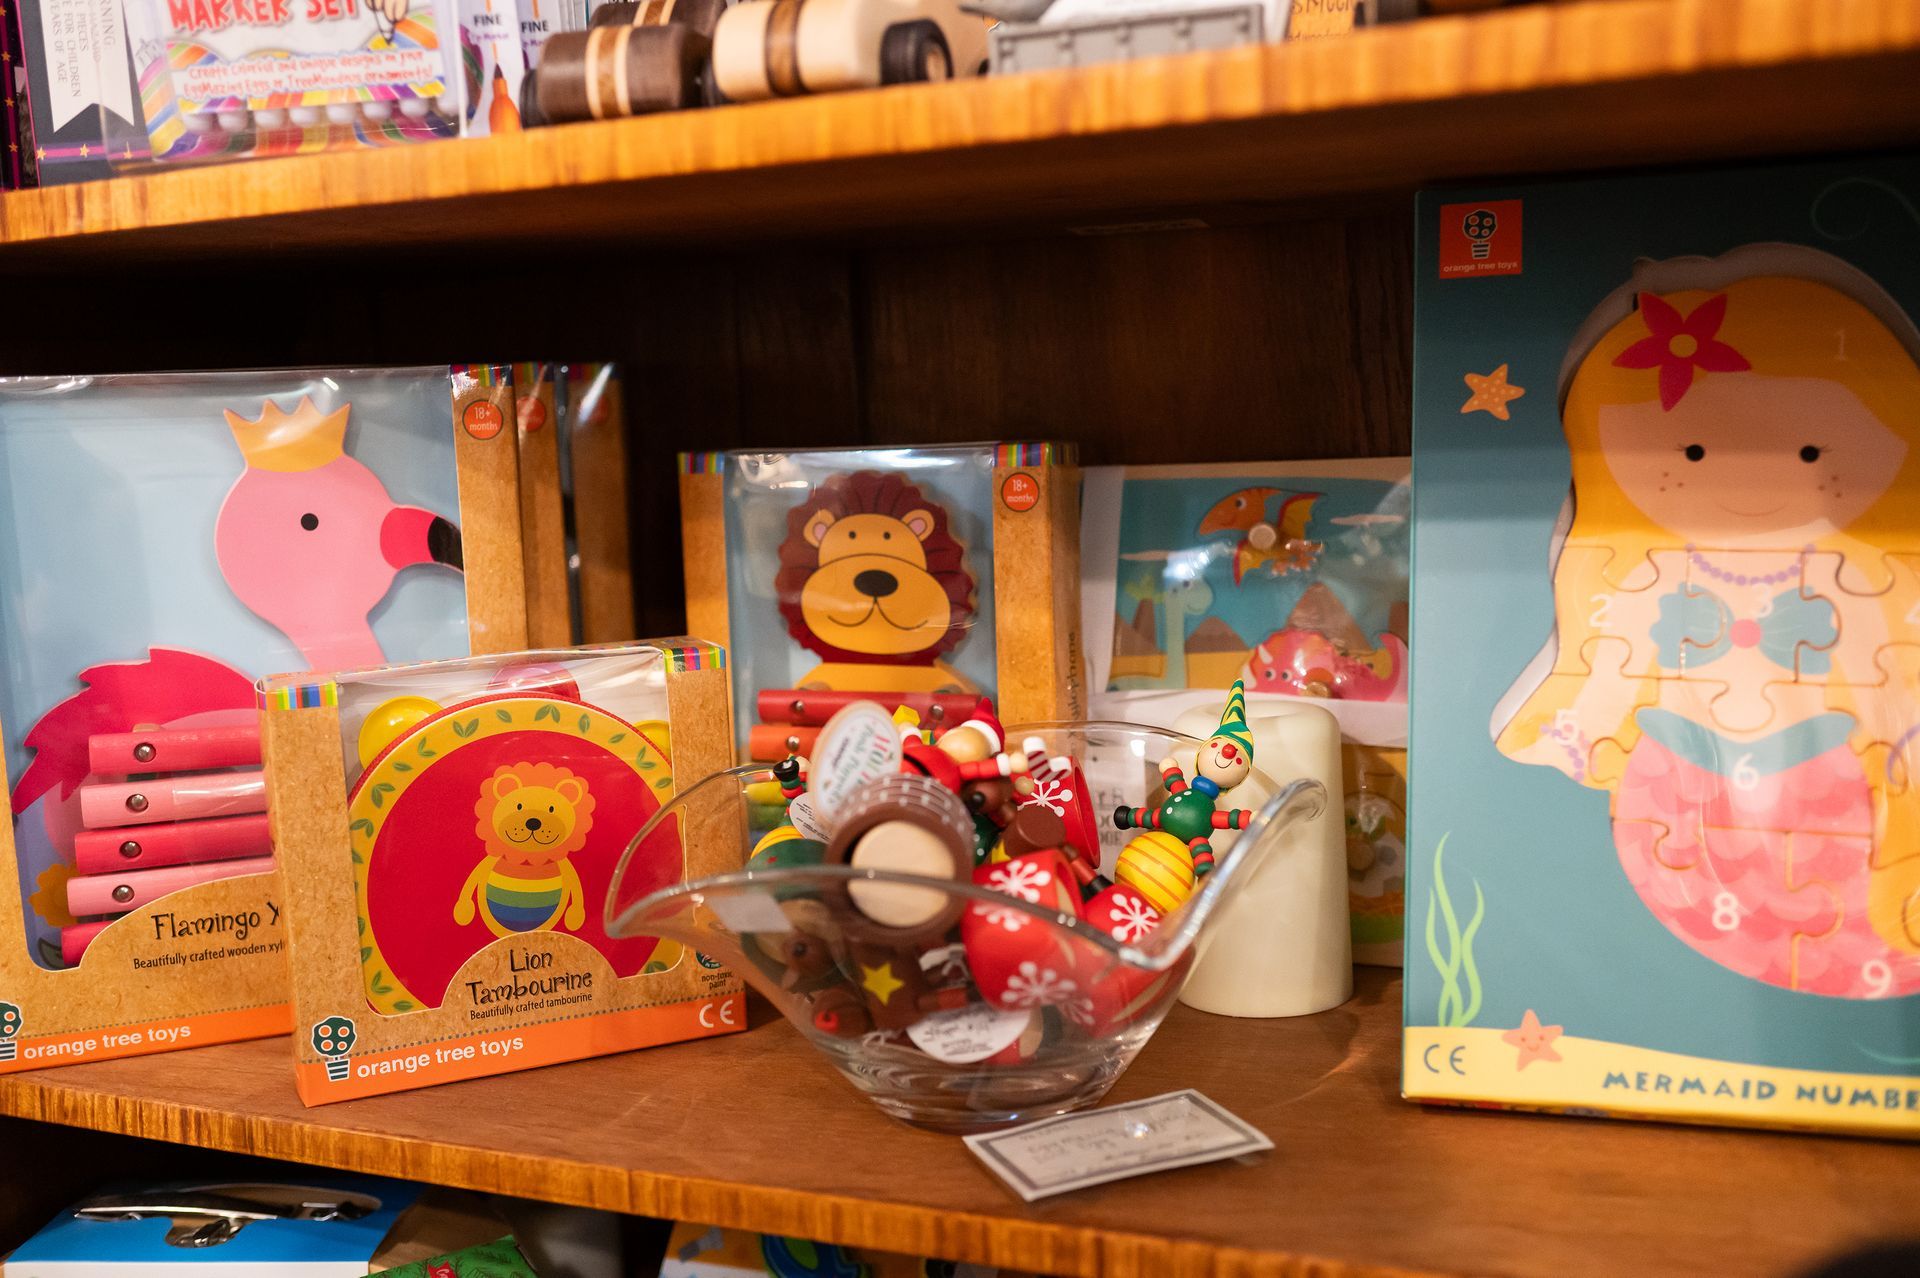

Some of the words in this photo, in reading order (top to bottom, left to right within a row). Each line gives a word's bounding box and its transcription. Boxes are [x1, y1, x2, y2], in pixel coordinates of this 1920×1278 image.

[51, 0, 62, 36] EARS
[473, 14, 502, 27] FINE
[520, 20, 549, 34] FINE
[67, 39, 81, 98] CHILDREN
[1443, 264, 1475, 273] orange
[1478, 262, 1496, 271] tree
[1498, 261, 1518, 271] toys
[469, 420, 499, 432] months
[474, 406, 491, 420] 18+
[1007, 492, 1035, 503] months
[1013, 479, 1028, 492] 18+
[1588, 593, 1614, 628] 2
[1555, 708, 1580, 747] 5
[1732, 752, 1760, 792] 6
[151, 911, 261, 941] Flamingo
[1711, 891, 1740, 931] 8
[133, 952, 188, 970] Beautifully
[189, 946, 226, 962] crafted
[226, 943, 267, 957] wooden
[509, 948, 554, 973] Lion
[465, 971, 593, 1006] Tambourine
[701, 971, 734, 982] non-toxic
[709, 979, 726, 991] paint
[1862, 958, 1893, 999] 9
[470, 1003, 514, 1021] Beautifully
[515, 1000, 545, 1013] crafted
[546, 992, 593, 1009] tambourine
[699, 999, 735, 1029] CE
[23, 1038, 98, 1060] orange
[102, 1032, 143, 1049] tree
[147, 1025, 192, 1043] toys
[356, 1053, 431, 1079] orange
[435, 1045, 476, 1065] tree
[480, 1036, 524, 1057] toys
[1423, 1043, 1466, 1075] CE
[1601, 1071, 1777, 1101] MERMAID
[1796, 1083, 1920, 1111] NUMBE
